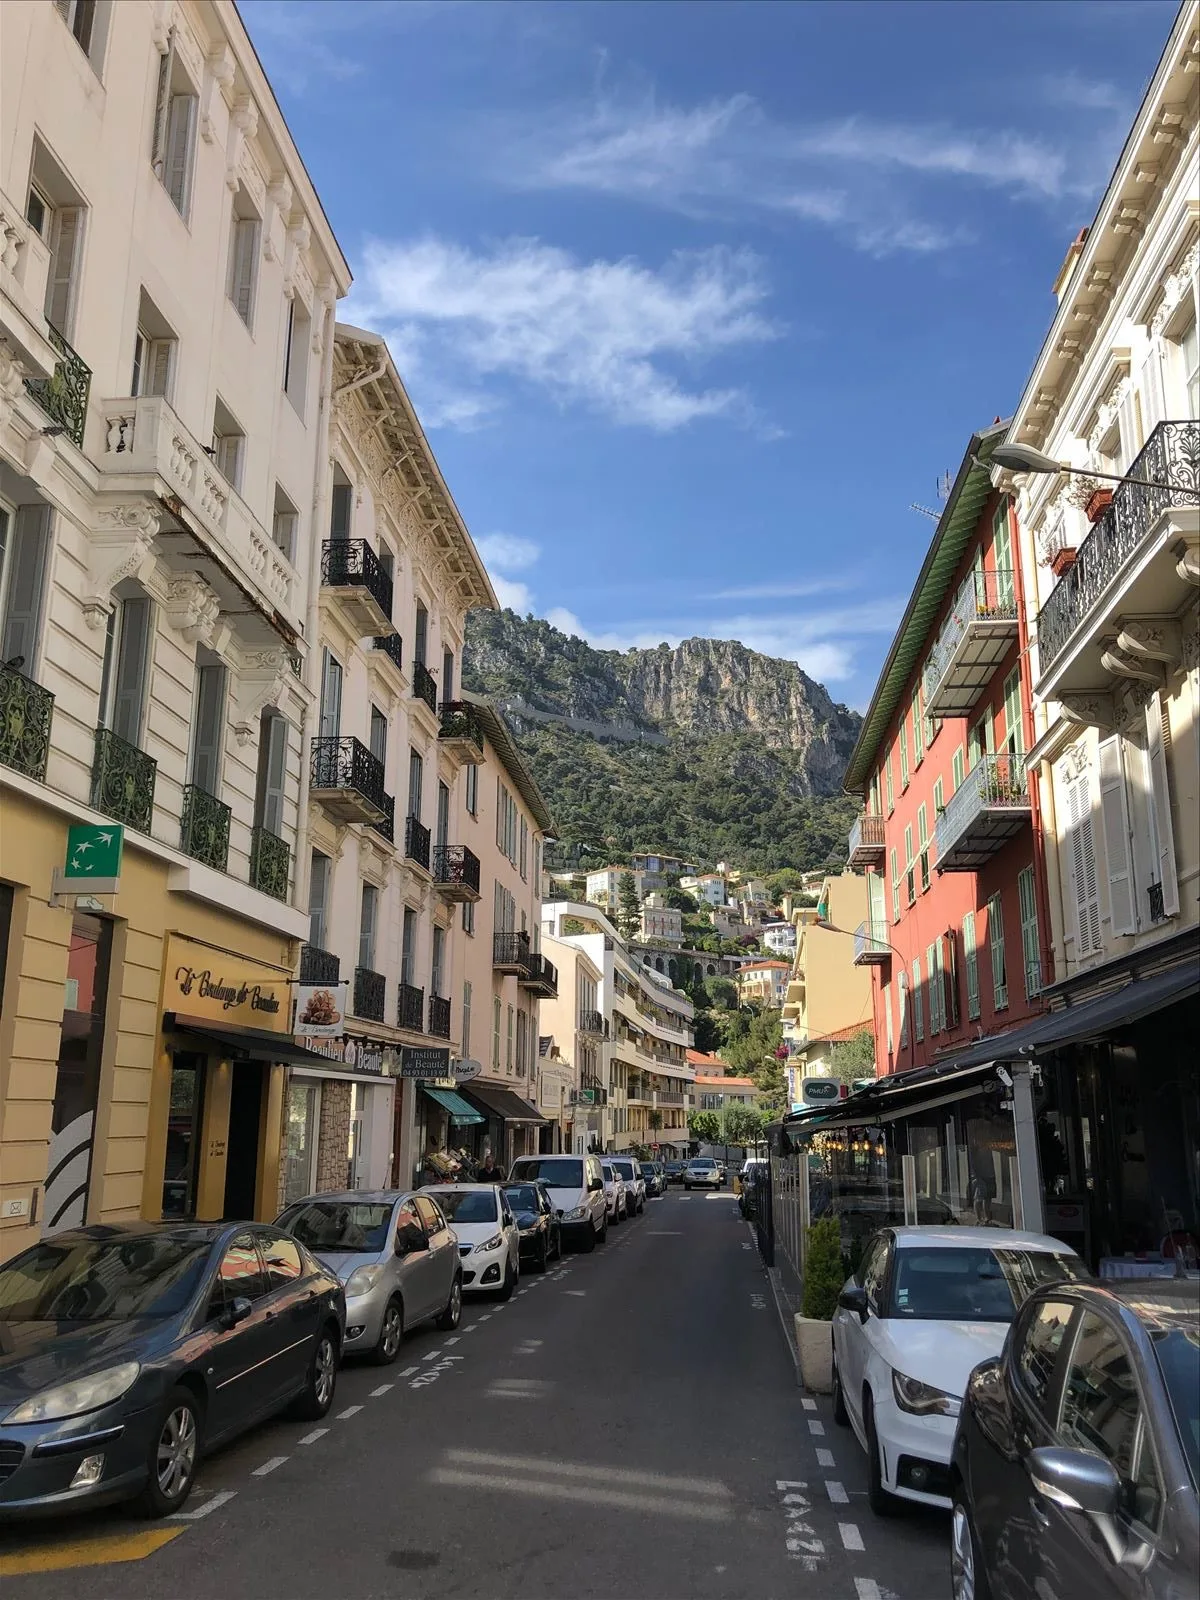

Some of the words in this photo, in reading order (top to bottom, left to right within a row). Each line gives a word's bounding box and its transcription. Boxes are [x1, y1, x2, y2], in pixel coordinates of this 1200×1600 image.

[357, 1046, 383, 1071] Beauté
[410, 1050, 441, 1059] Institut
[415, 1059, 446, 1069] Beauté
